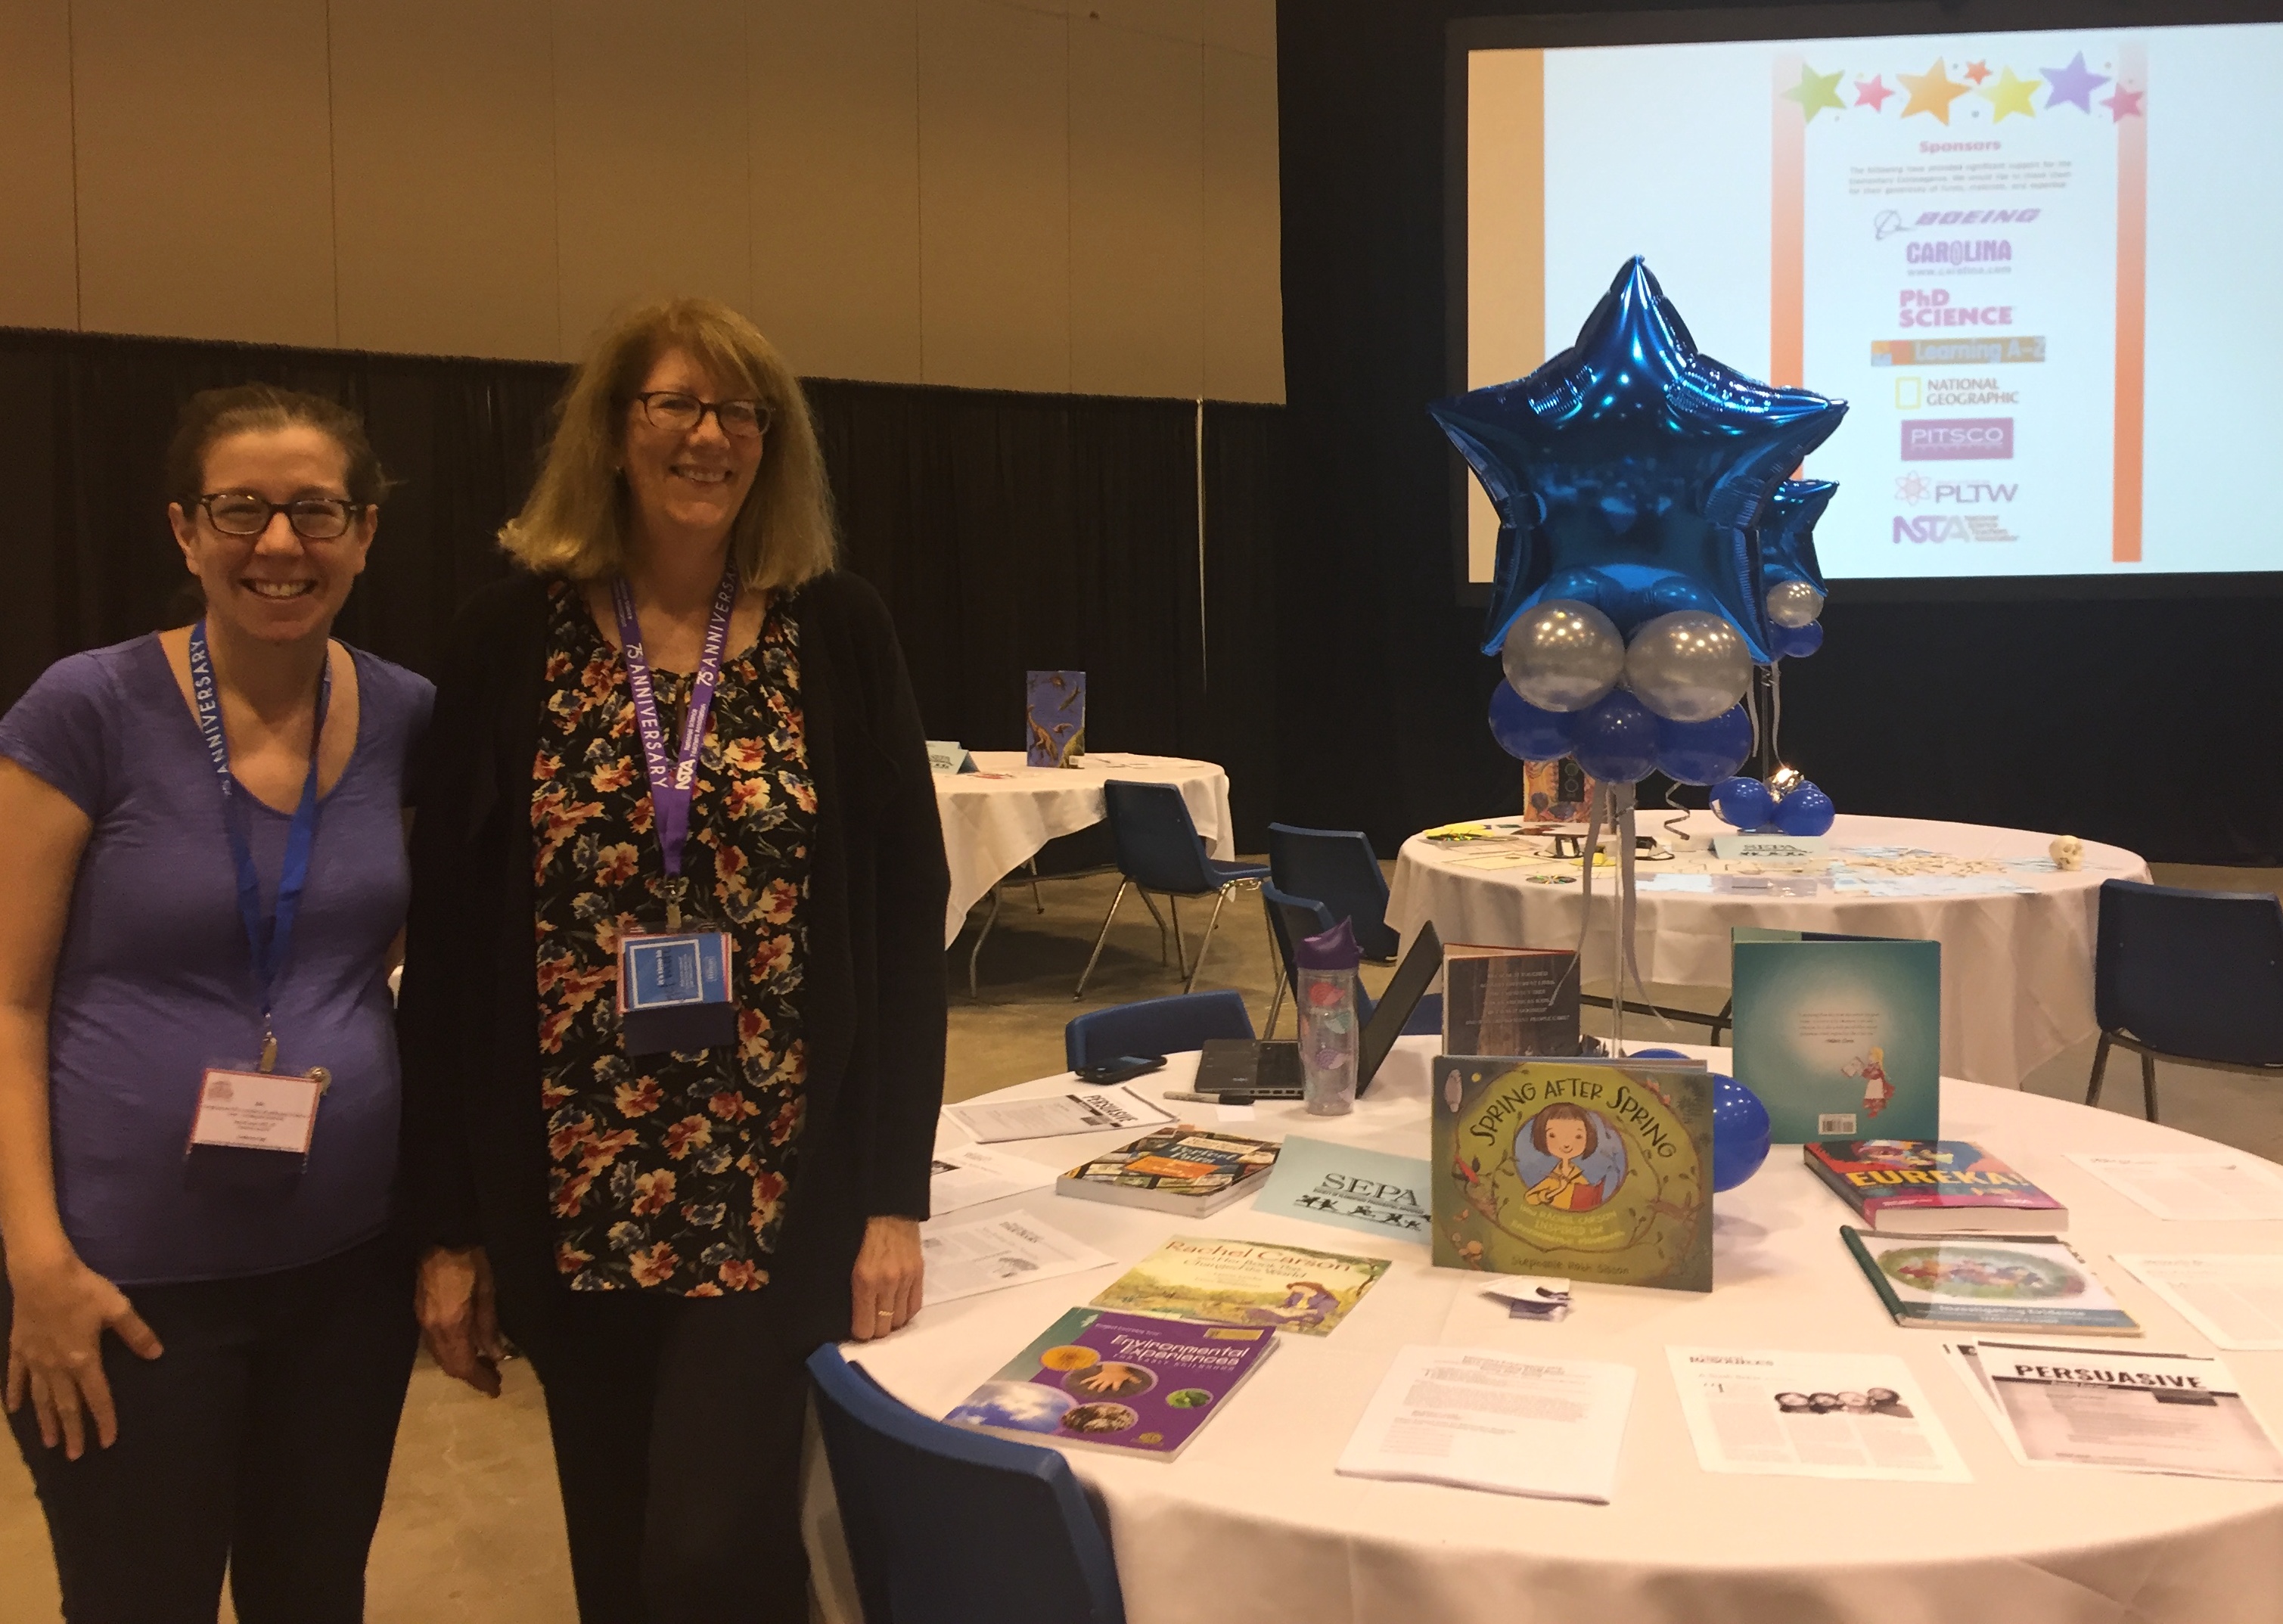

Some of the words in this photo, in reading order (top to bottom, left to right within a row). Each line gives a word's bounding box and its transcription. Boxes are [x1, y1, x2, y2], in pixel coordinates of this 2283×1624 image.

[1919, 141, 2002, 154] Sponsors
[1915, 208, 2042, 225] BOEING
[1906, 240, 2012, 265] CAROLINA
[1906, 266, 2012, 276] www.carolina.com
[1899, 288, 1950, 307] PhD
[1899, 306, 2013, 328] SCIENCE
[1915, 340, 2002, 363] Learning
[1927, 377, 2000, 391] NATIONAL
[1926, 390, 2020, 406] GEOGRAPHIC
[1911, 427, 2004, 444] PITSCO
[1935, 483, 2019, 504] PLTW
[1893, 515, 1971, 544] NSTA
[191, 640, 229, 774] ANNIVERSARY
[629, 663, 669, 788] ANNIVERSARY
[675, 759, 696, 790] NSTA
[1469, 1082, 1537, 1147] SPRING
[1543, 1077, 1604, 1101] AFTER
[1606, 1085, 1678, 1159] SPRING
[1321, 1172, 1419, 1206] SEPA
[1845, 1169, 2032, 1187] EUREKA!
[1165, 1241, 1253, 1258] Rachel
[1257, 1250, 1351, 1272] Carson
[1265, 1266, 1307, 1278] World
[1110, 1334, 1250, 1359] Environmental
[1120, 1344, 1241, 1366] Experiences
[2013, 1364, 2207, 1389] PERSUASIVE
